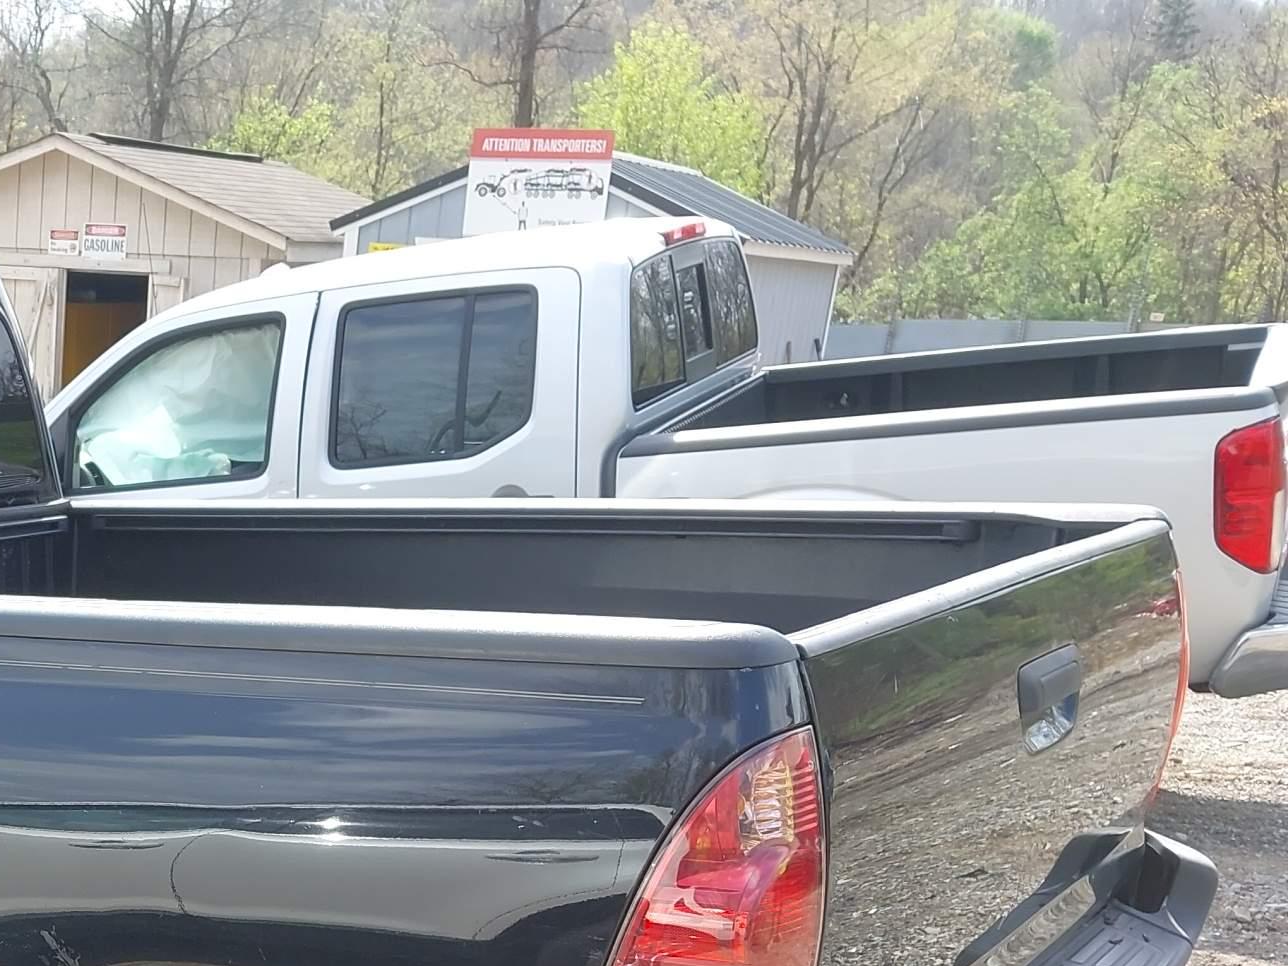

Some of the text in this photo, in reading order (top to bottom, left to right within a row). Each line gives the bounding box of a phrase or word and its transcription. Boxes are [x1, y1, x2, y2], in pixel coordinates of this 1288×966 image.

[482, 138, 607, 154] ATTENTION TRANSPORTERS!
[83, 238, 125, 253] GASOLINE
